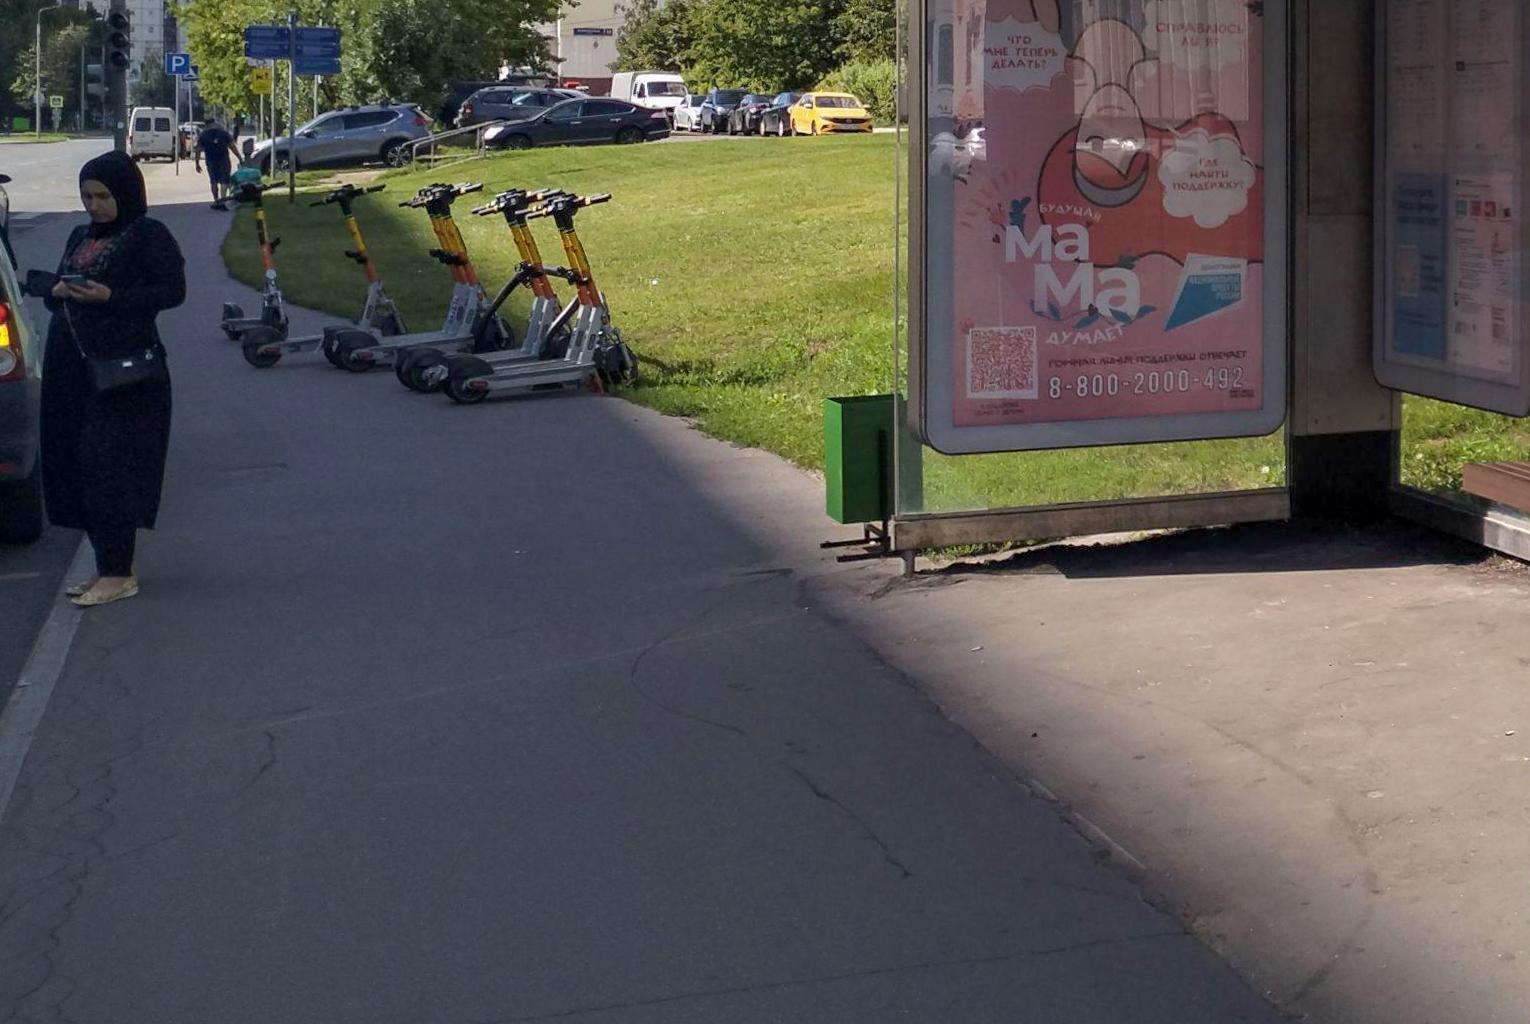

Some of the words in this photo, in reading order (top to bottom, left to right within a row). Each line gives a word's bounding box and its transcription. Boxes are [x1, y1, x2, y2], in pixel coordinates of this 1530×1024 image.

[1007, 35, 1032, 45] ЧТО
[983, 47, 1009, 57] МНЕ
[1015, 47, 1058, 57] ТЕПЕРЬ
[991, 58, 1048, 70] ДЕЛАТЬ?
[1045, 324, 1125, 345] ДУМАЕТ
[1048, 366, 1245, 400] 8-800-2000-492
